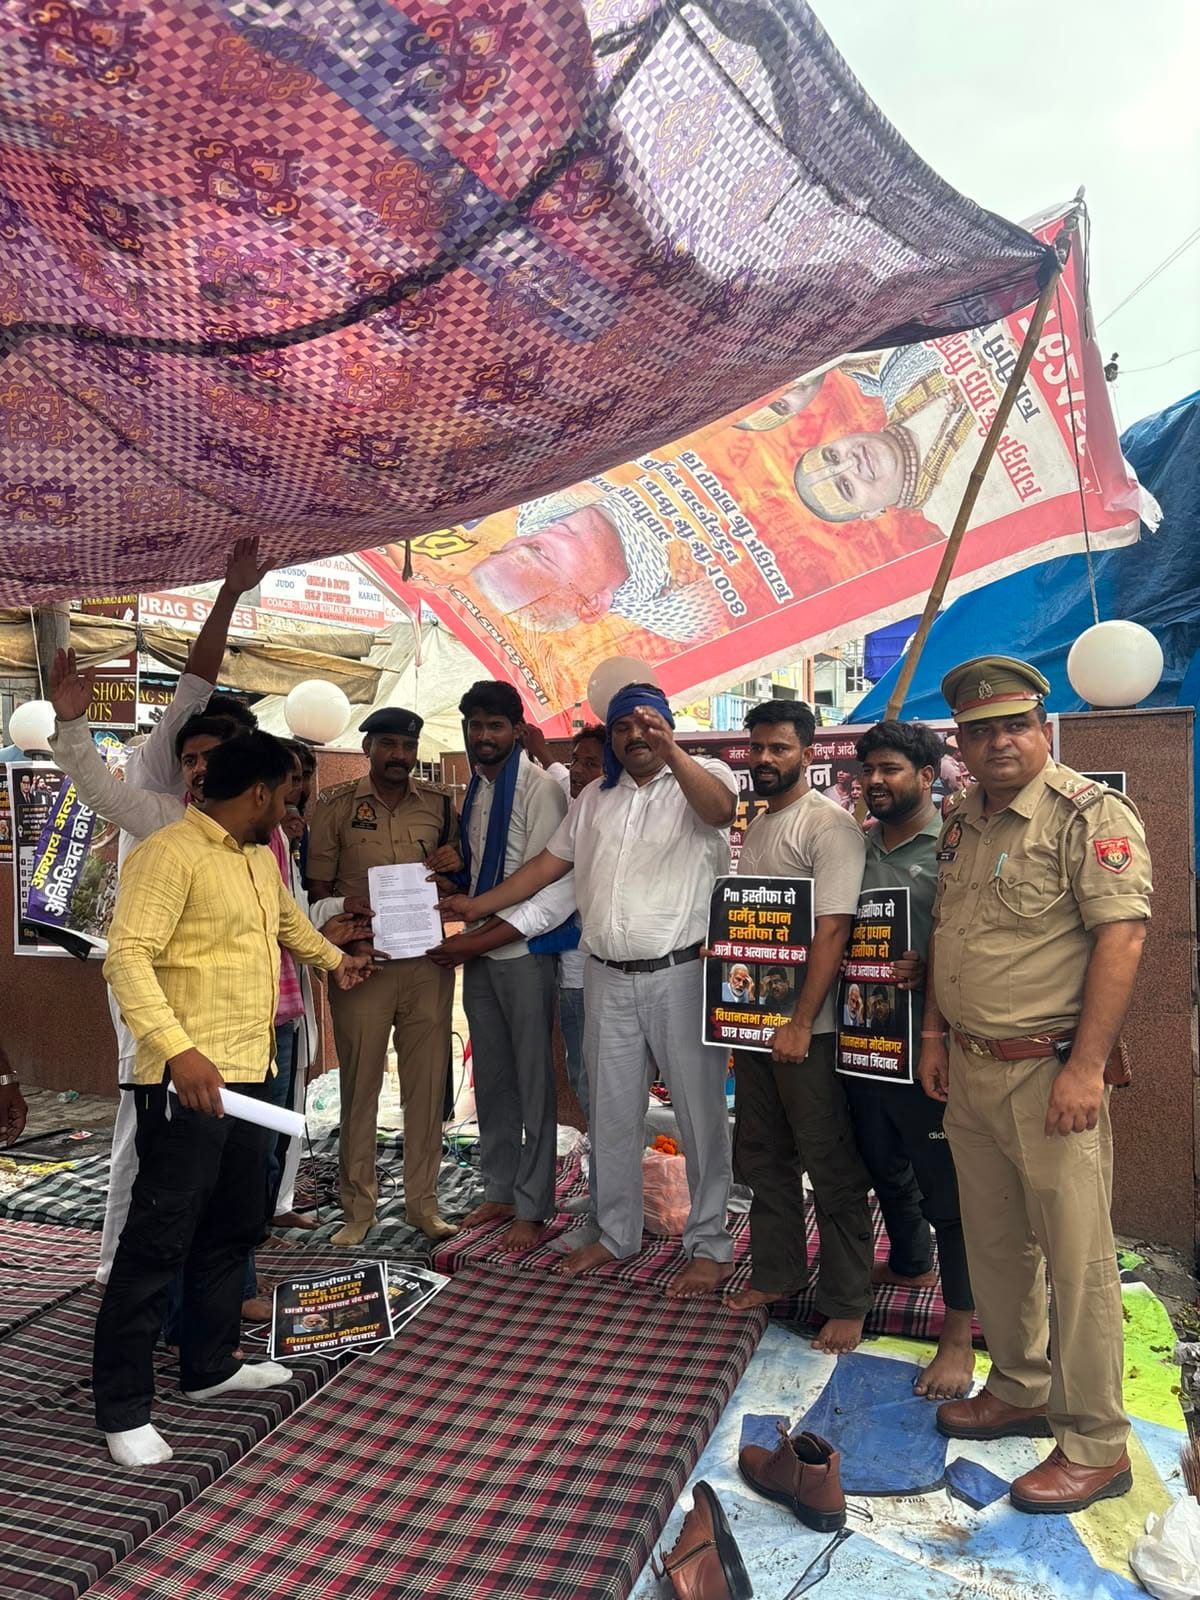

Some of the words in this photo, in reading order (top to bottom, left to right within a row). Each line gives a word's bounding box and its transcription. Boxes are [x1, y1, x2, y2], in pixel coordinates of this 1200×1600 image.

[334, 562, 358, 573] ACAD
[275, 579, 294, 589] JUDO
[358, 591, 381, 602] KARATE
[300, 601, 317, 611] UDAY
[320, 602, 343, 614] KUMAR
[92, 681, 136, 701] SHOES
[87, 703, 113, 722] OTS
[729, 747, 750, 759] जंतर-
[838, 743, 857, 756] आंदो
[31, 832, 62, 890] अन्याय
[45, 839, 84, 917] अनिश्चित
[724, 888, 739, 902] Pm
[742, 887, 781, 904] इस्तीफा
[784, 888, 796, 904] दो
[885, 899, 895, 917] दो
[759, 911, 791, 924] प्रधान
[729, 924, 773, 940] इस्तीफा
[776, 926, 789, 942] दो
[867, 926, 891, 940] प्रधान
[714, 943, 731, 955] छात्रों
[733, 946, 743, 956] पर
[745, 946, 777, 958] अत्याचार
[779, 946, 789, 959] बंद
[791, 948, 806, 960] करो
[879, 941, 889, 958] दो
[715, 1008, 760, 1024] विधानसभा
[762, 1013, 791, 1027] मोदीन
[721, 1026, 737, 1037] छात्र
[739, 1028, 760, 1040] एकता
[869, 1036, 902, 1053] मोदीनगर
[853, 1054, 868, 1066] एकता
[870, 1053, 898, 1070] जिंदाबाद
[292, 1282, 310, 1290] Pm
[313, 1276, 351, 1289] इस्तीफा
[354, 1272, 365, 1281] दो
[329, 1281, 362, 1295] प्रधान
[300, 1294, 345, 1306] इस्तीफा
[286, 1333, 337, 1345] विधानसभा
[339, 1323, 380, 1337] मोदीनगर
[340, 1331, 377, 1343] जिंदाबाद
